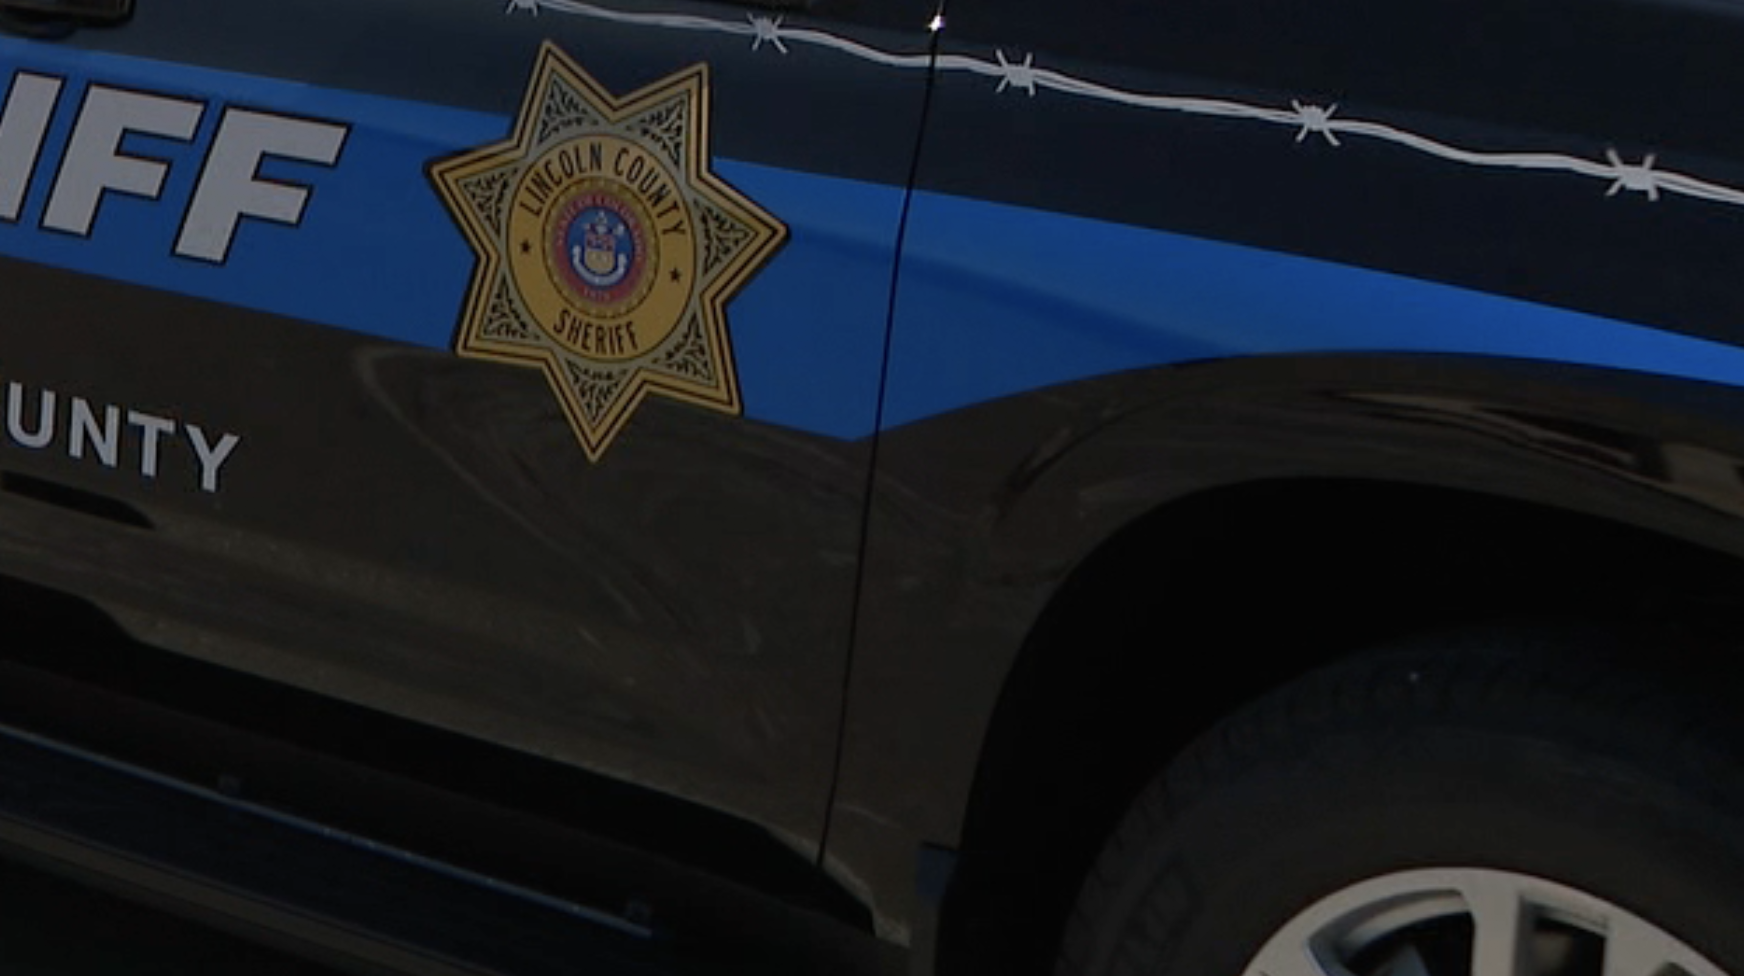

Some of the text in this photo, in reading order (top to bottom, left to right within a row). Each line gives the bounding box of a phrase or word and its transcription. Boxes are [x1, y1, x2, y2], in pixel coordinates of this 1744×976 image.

[518, 142, 603, 217] LINCOLN
[613, 146, 687, 237] COUNTY
[552, 308, 639, 355] SHERIFF
